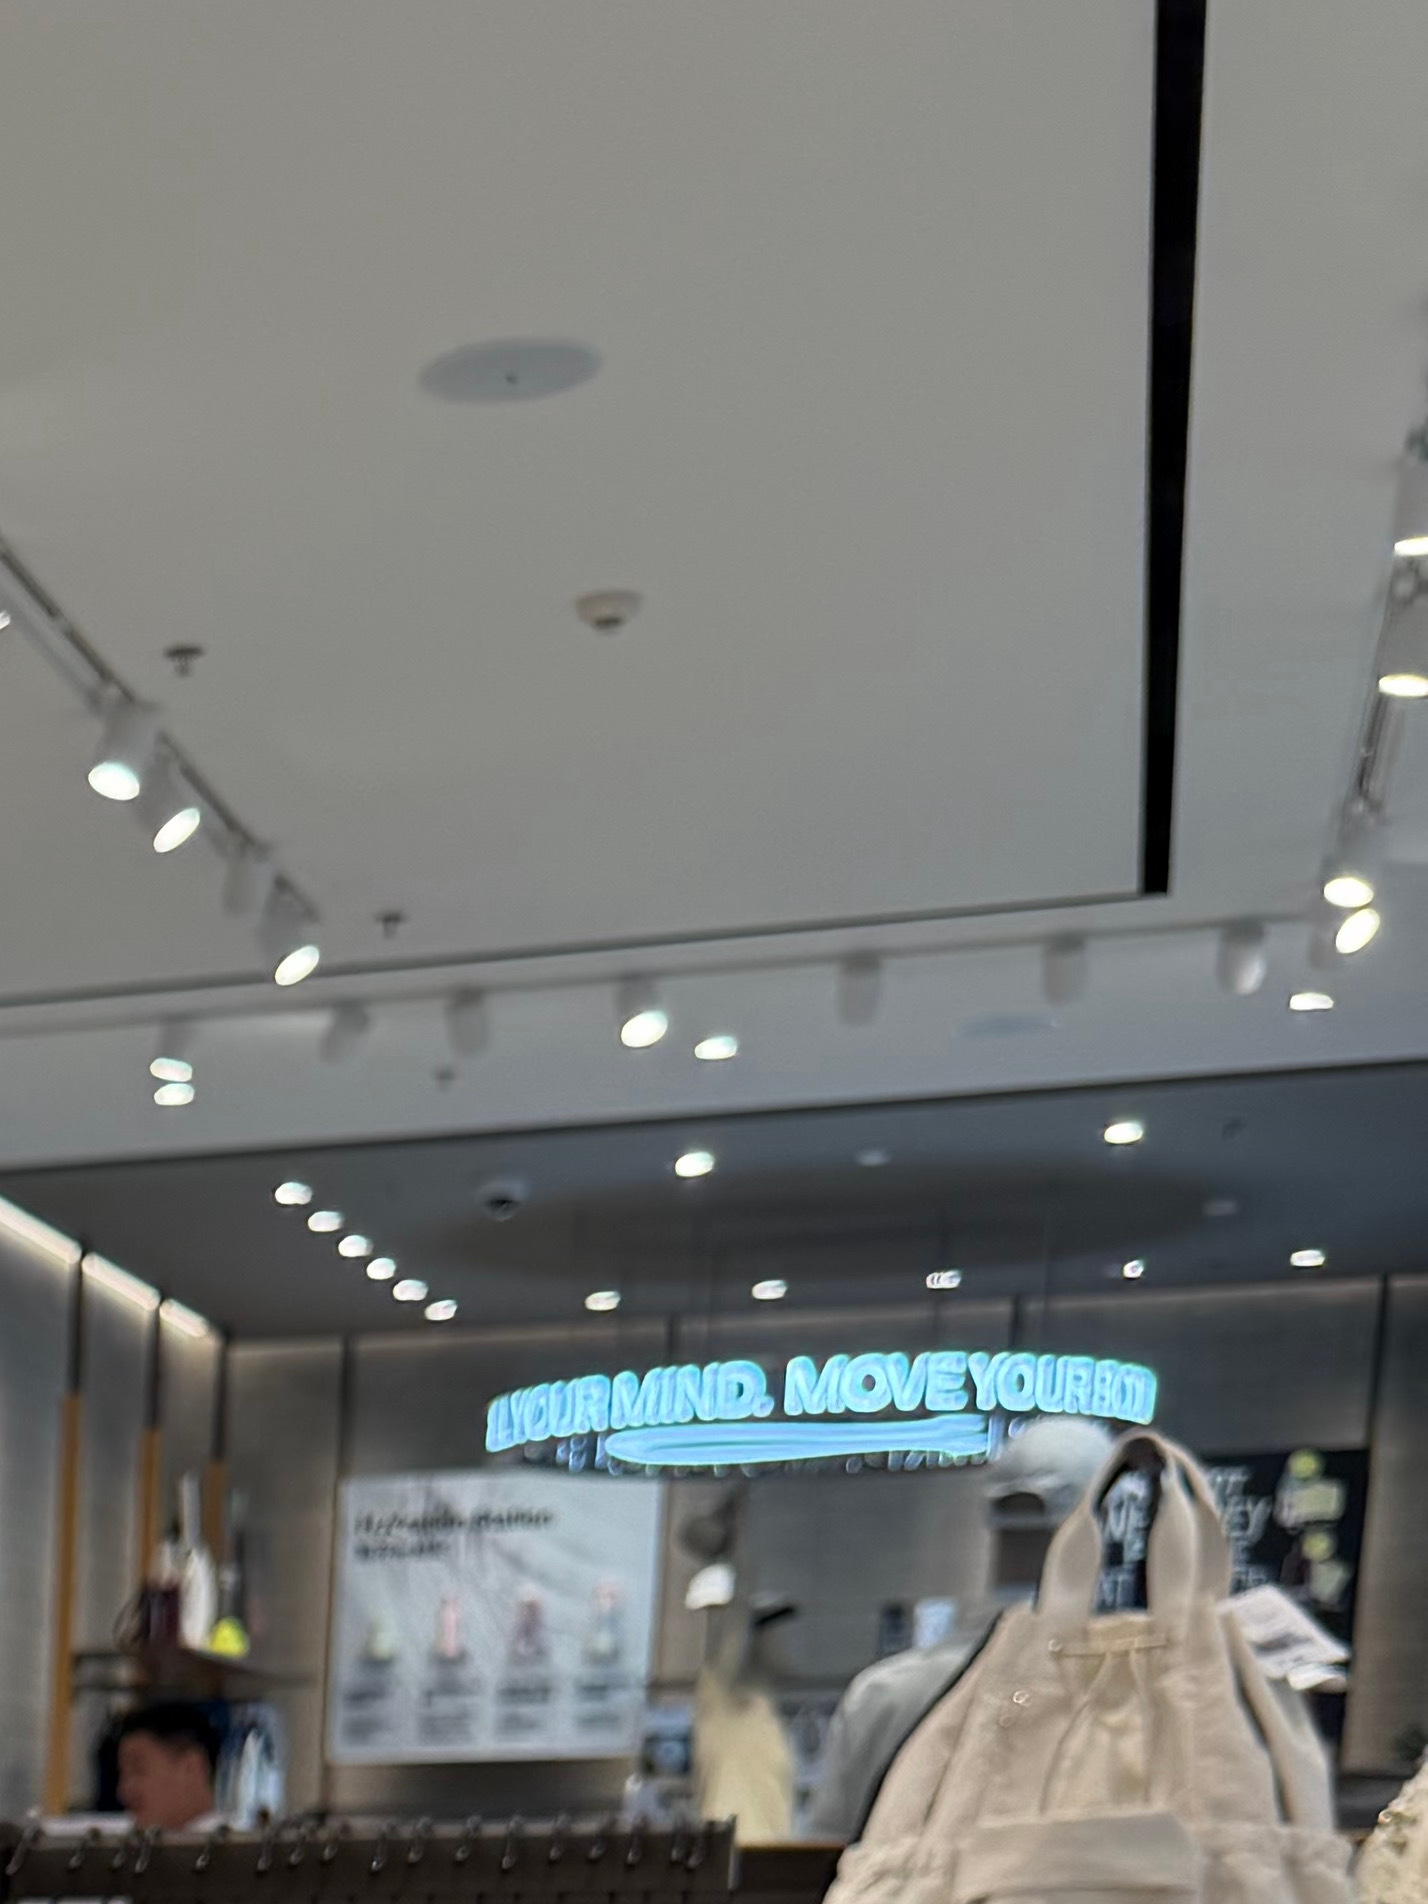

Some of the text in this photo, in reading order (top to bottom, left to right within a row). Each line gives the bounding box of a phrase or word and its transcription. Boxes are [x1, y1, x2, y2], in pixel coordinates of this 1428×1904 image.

[609, 1360, 775, 1430] MIND.
[783, 1351, 968, 1416] MOVE
[966, 1352, 1097, 1416] YOUR
